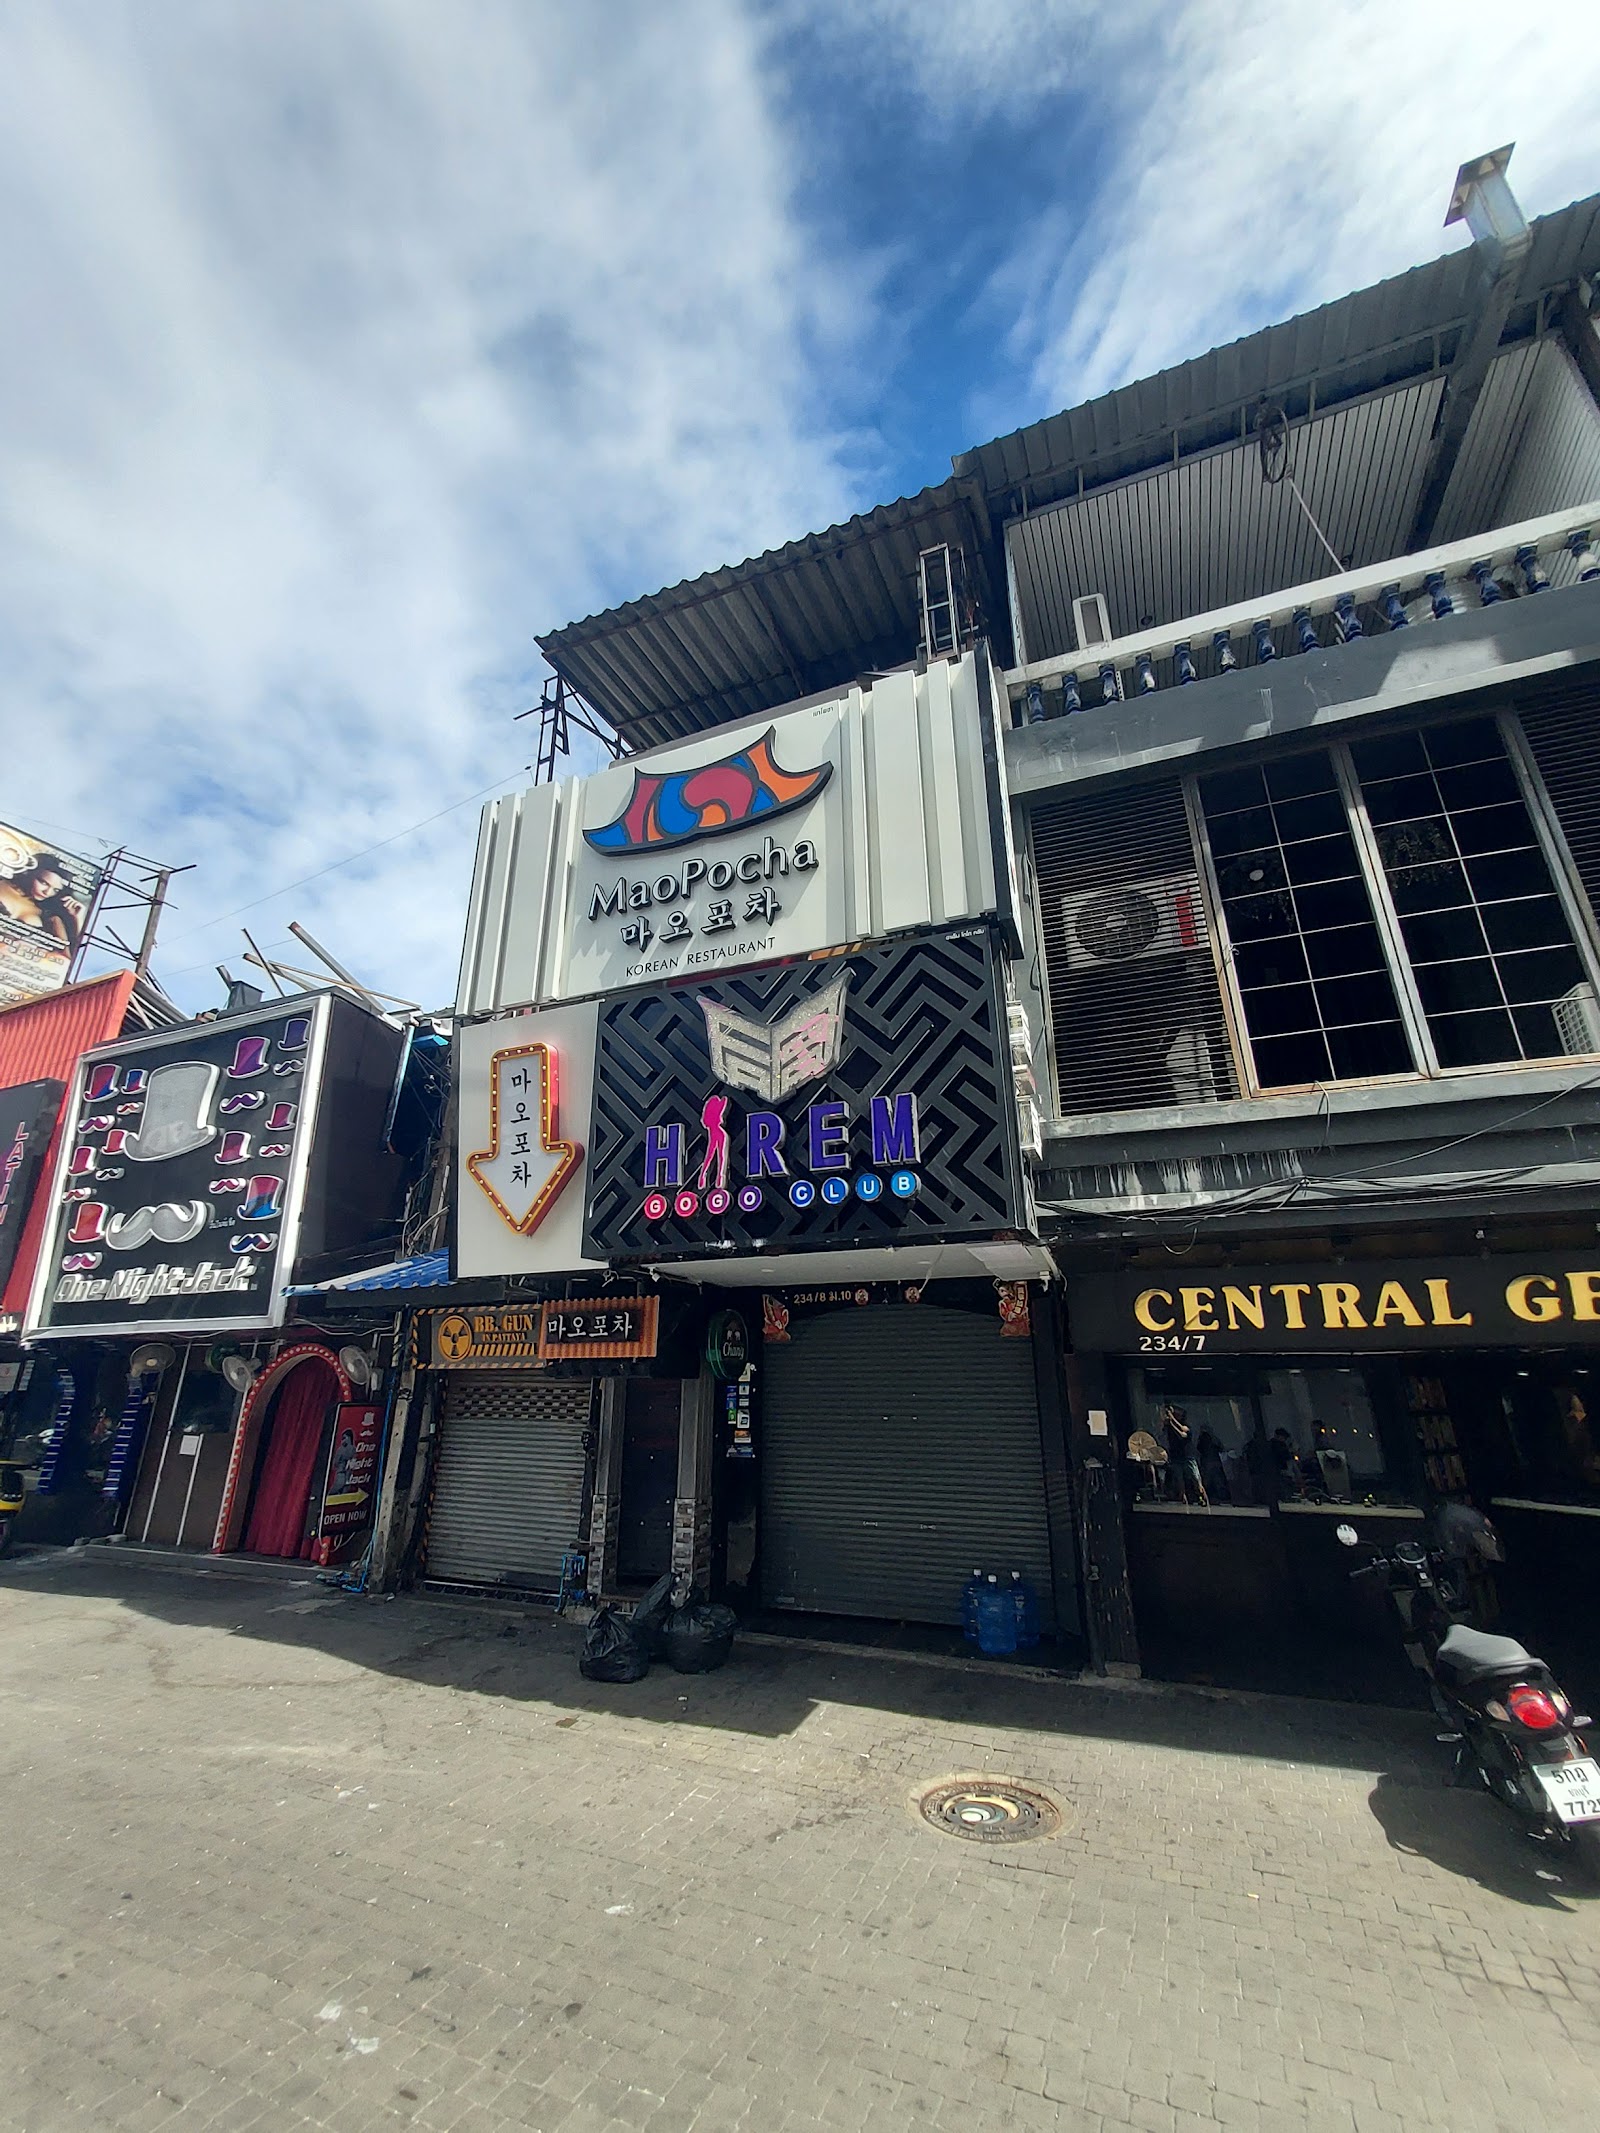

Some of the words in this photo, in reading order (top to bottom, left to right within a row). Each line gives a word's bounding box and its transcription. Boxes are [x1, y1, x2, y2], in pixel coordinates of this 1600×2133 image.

[588, 835, 819, 921] MaoPocha
[620, 886, 783, 953] 마오포차
[625, 957, 679, 977] KOREAN
[687, 936, 776, 966] RESTAURANT
[510, 1067, 532, 1189] 마오포차
[646, 1187, 761, 1217] GOGO
[791, 1171, 917, 1206] CLUB
[54, 1273, 108, 1302] One
[104, 1263, 185, 1304] Night
[181, 1256, 255, 1294] Jack
[793, 1292, 827, 1304] 234/8
[1134, 1278, 1473, 1332] CENTRAL
[502, 1314, 534, 1332] GUN
[547, 1311, 633, 1340] 마오포차
[482, 1334, 492, 1343] IN
[492, 1332, 528, 1343] PATTAYA
[1139, 1335, 1207, 1352] 234/7
[723, 1342, 744, 1360] Chang
[355, 1441, 376, 1453] One
[345, 1458, 374, 1471] Night
[345, 1473, 371, 1486] Jack
[323, 1512, 346, 1525] OPEN
[347, 1510, 368, 1522] NOW
